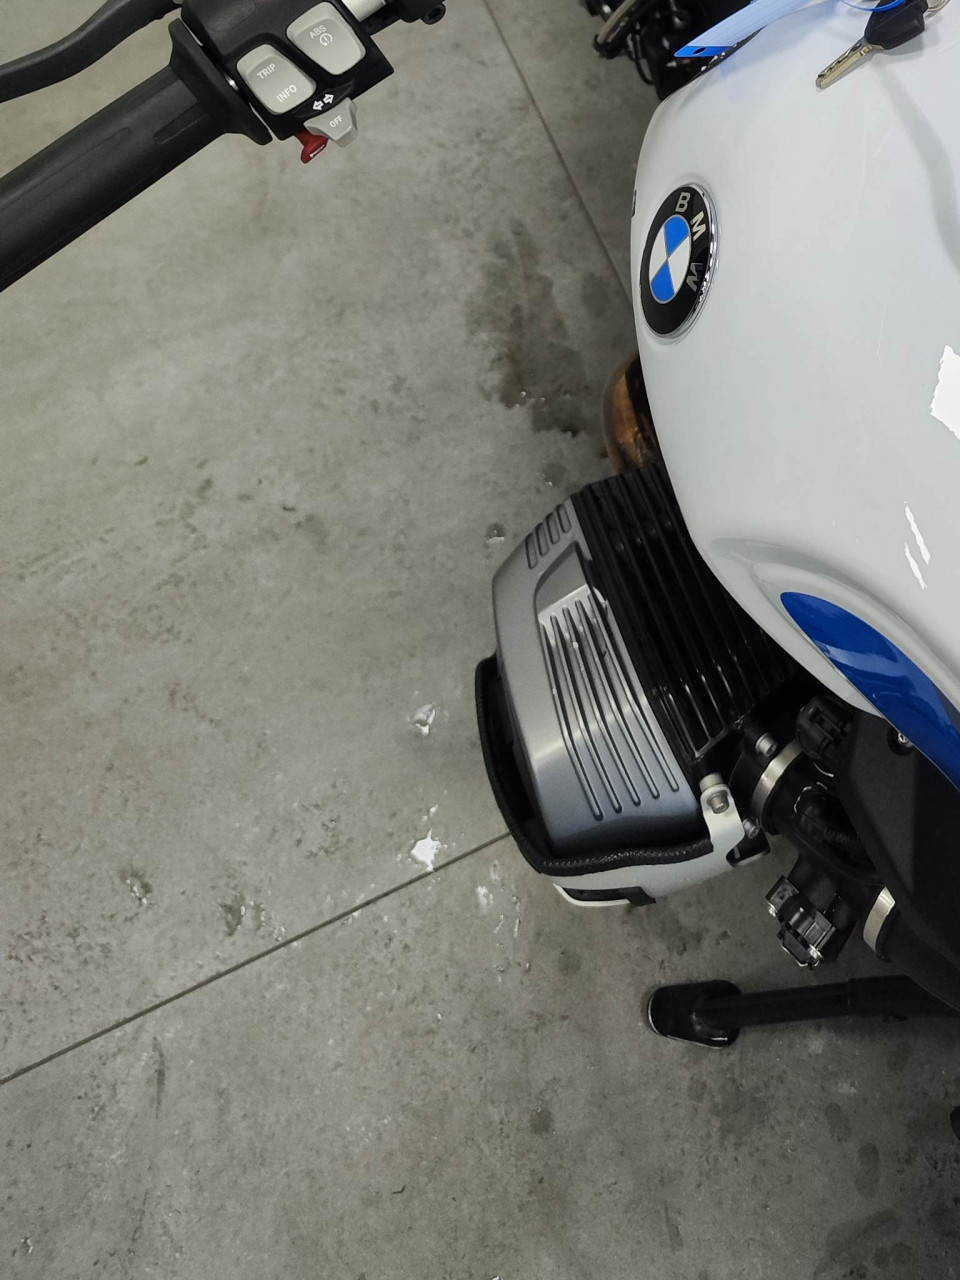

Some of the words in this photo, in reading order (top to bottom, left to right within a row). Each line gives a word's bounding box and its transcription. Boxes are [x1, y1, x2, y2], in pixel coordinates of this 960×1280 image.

[309, 24, 327, 39] ABS
[256, 63, 276, 79] TRIP
[276, 84, 297, 102] INFO
[329, 115, 343, 128] OFF
[675, 191, 707, 292] BMW
